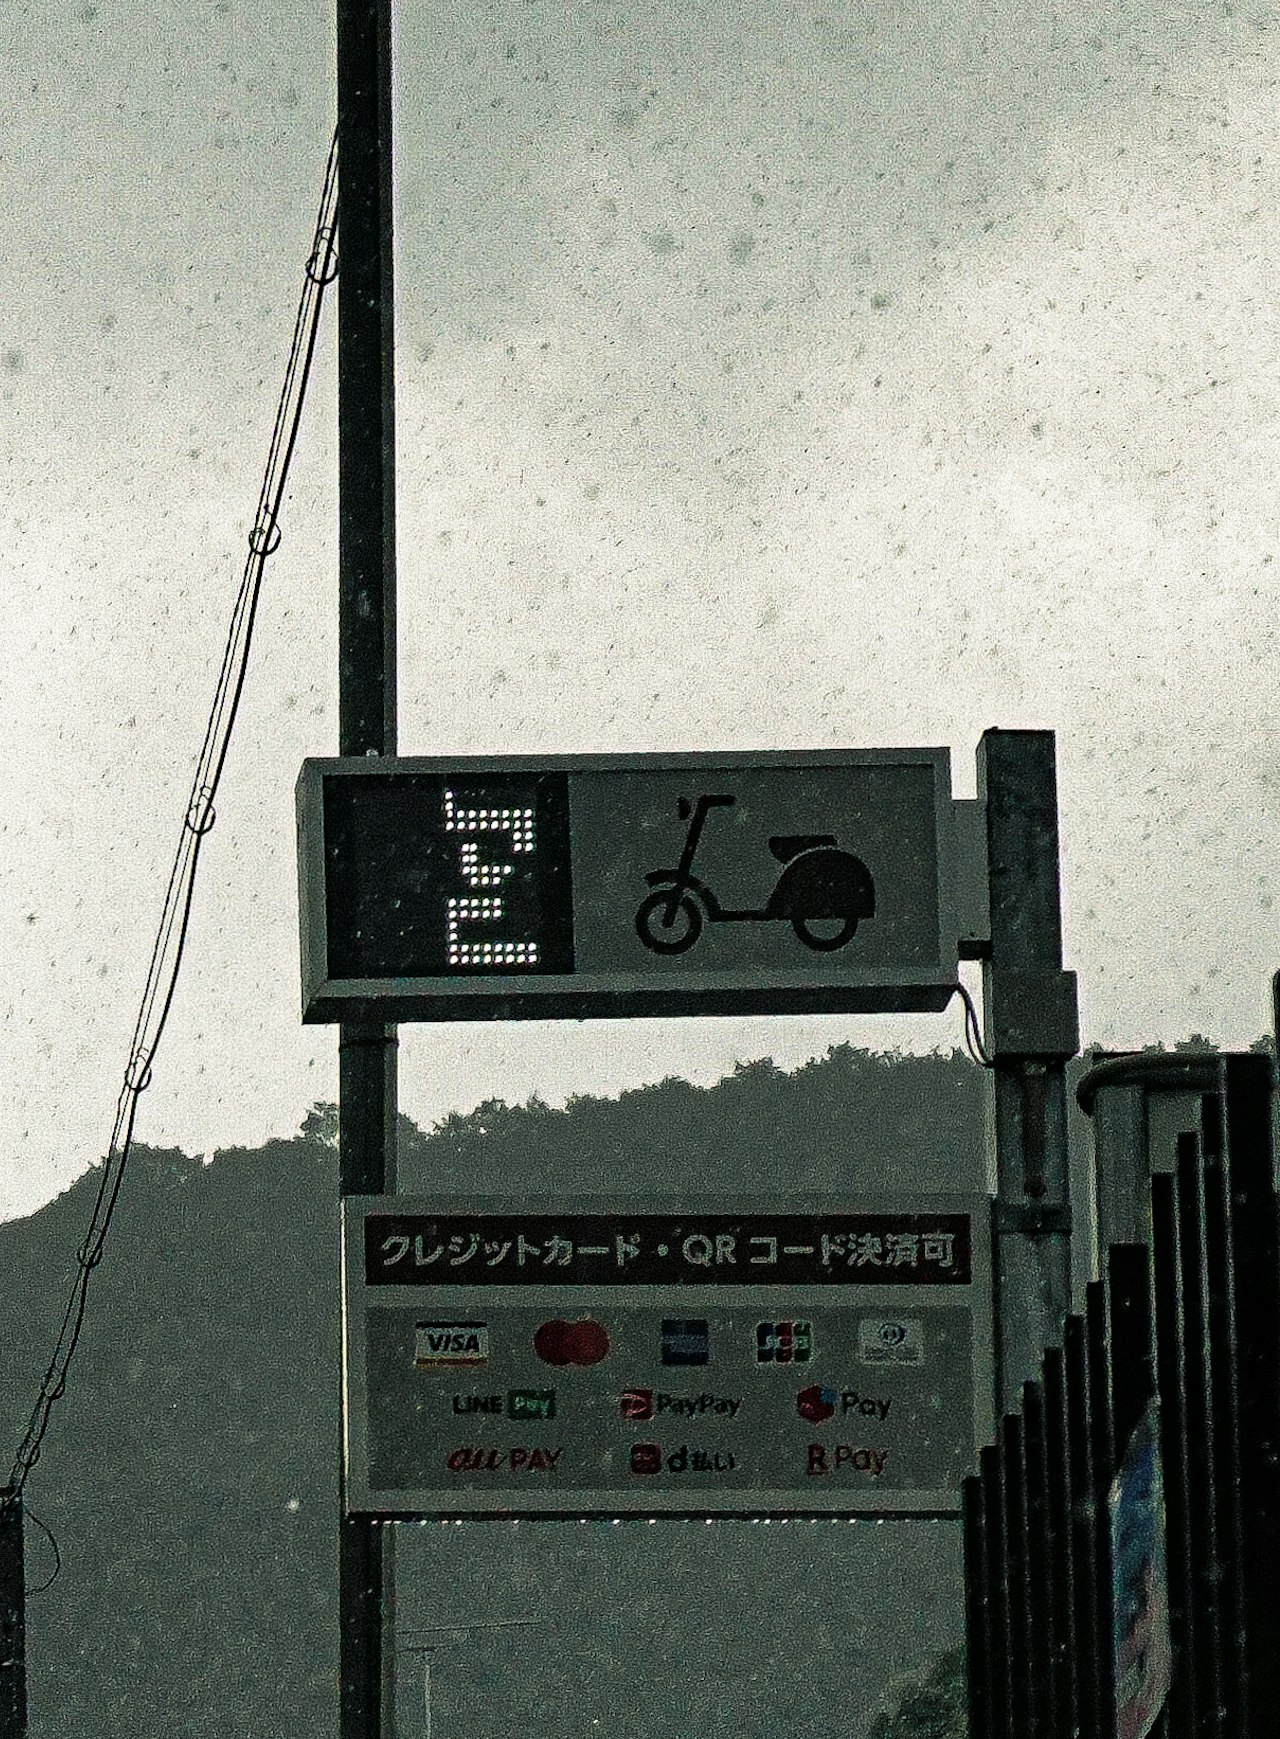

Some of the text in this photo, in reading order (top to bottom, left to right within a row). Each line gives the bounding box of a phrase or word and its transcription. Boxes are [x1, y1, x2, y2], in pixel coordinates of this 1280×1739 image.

[427, 1334, 480, 1353] VISA
[452, 1395, 503, 1415] LINE
[656, 1393, 742, 1419] PayPay
[841, 1392, 891, 1421] Pay
[447, 1447, 563, 1472] au PAY
[834, 1445, 890, 1476] Pay
